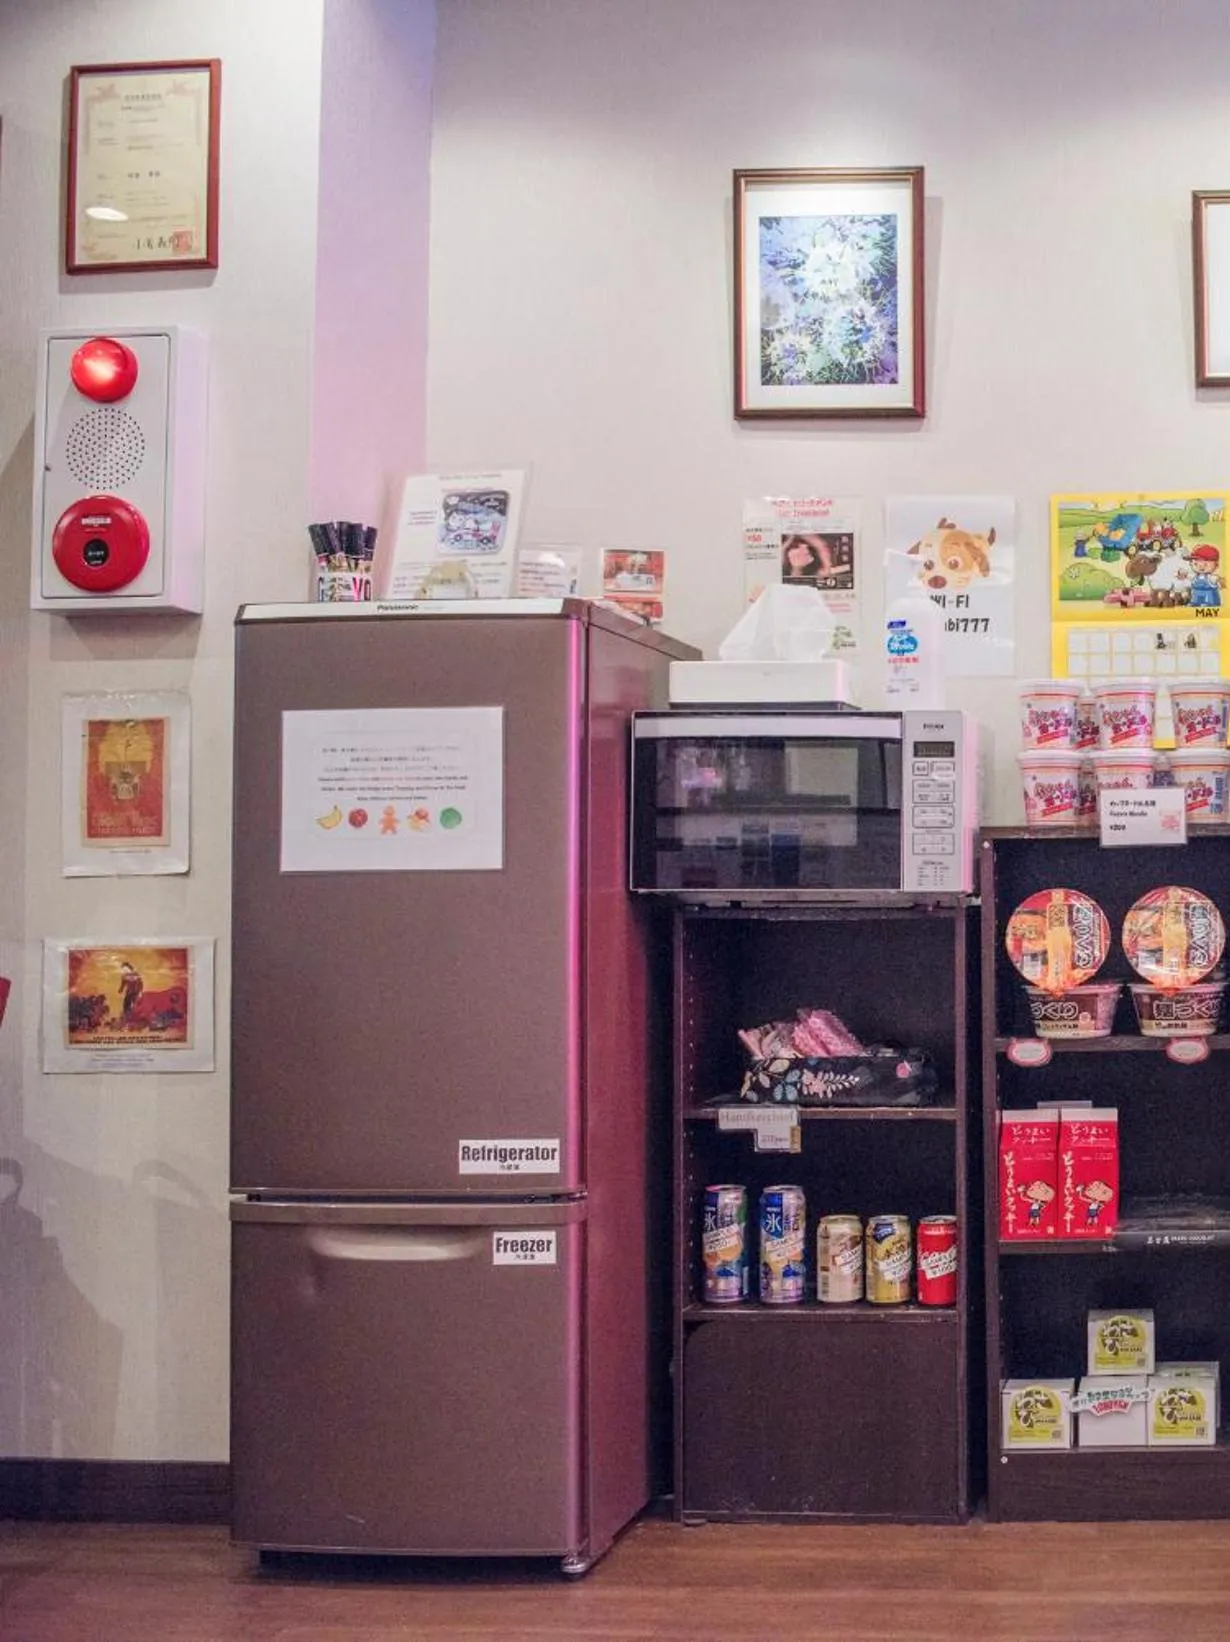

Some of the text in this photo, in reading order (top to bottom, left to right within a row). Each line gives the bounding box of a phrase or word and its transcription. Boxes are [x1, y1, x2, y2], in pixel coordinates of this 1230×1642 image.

[1195, 608, 1220, 618] MAY
[461, 1145, 558, 1163] Refrigerator
[495, 1237, 553, 1253] Freezer
